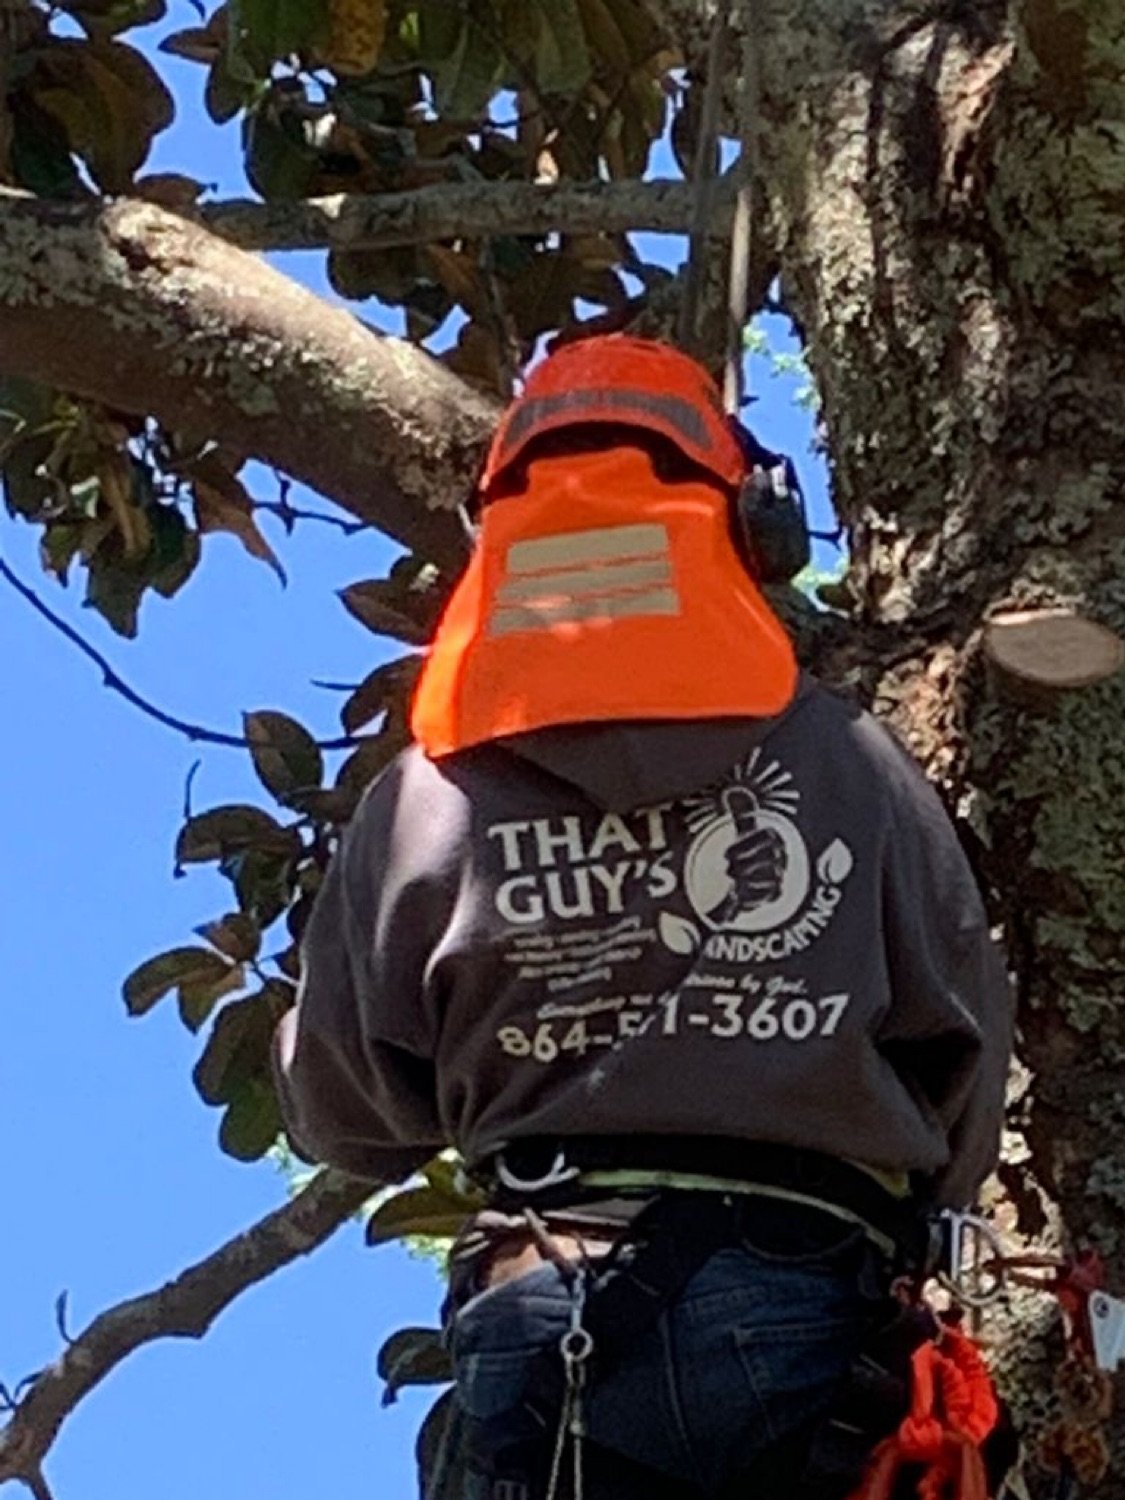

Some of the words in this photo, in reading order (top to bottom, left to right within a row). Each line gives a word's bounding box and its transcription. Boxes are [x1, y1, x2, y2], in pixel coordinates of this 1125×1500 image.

[487, 801, 674, 871] THAT
[495, 851, 678, 924] GUY'S
[702, 886, 842, 962] ANDSCAPING
